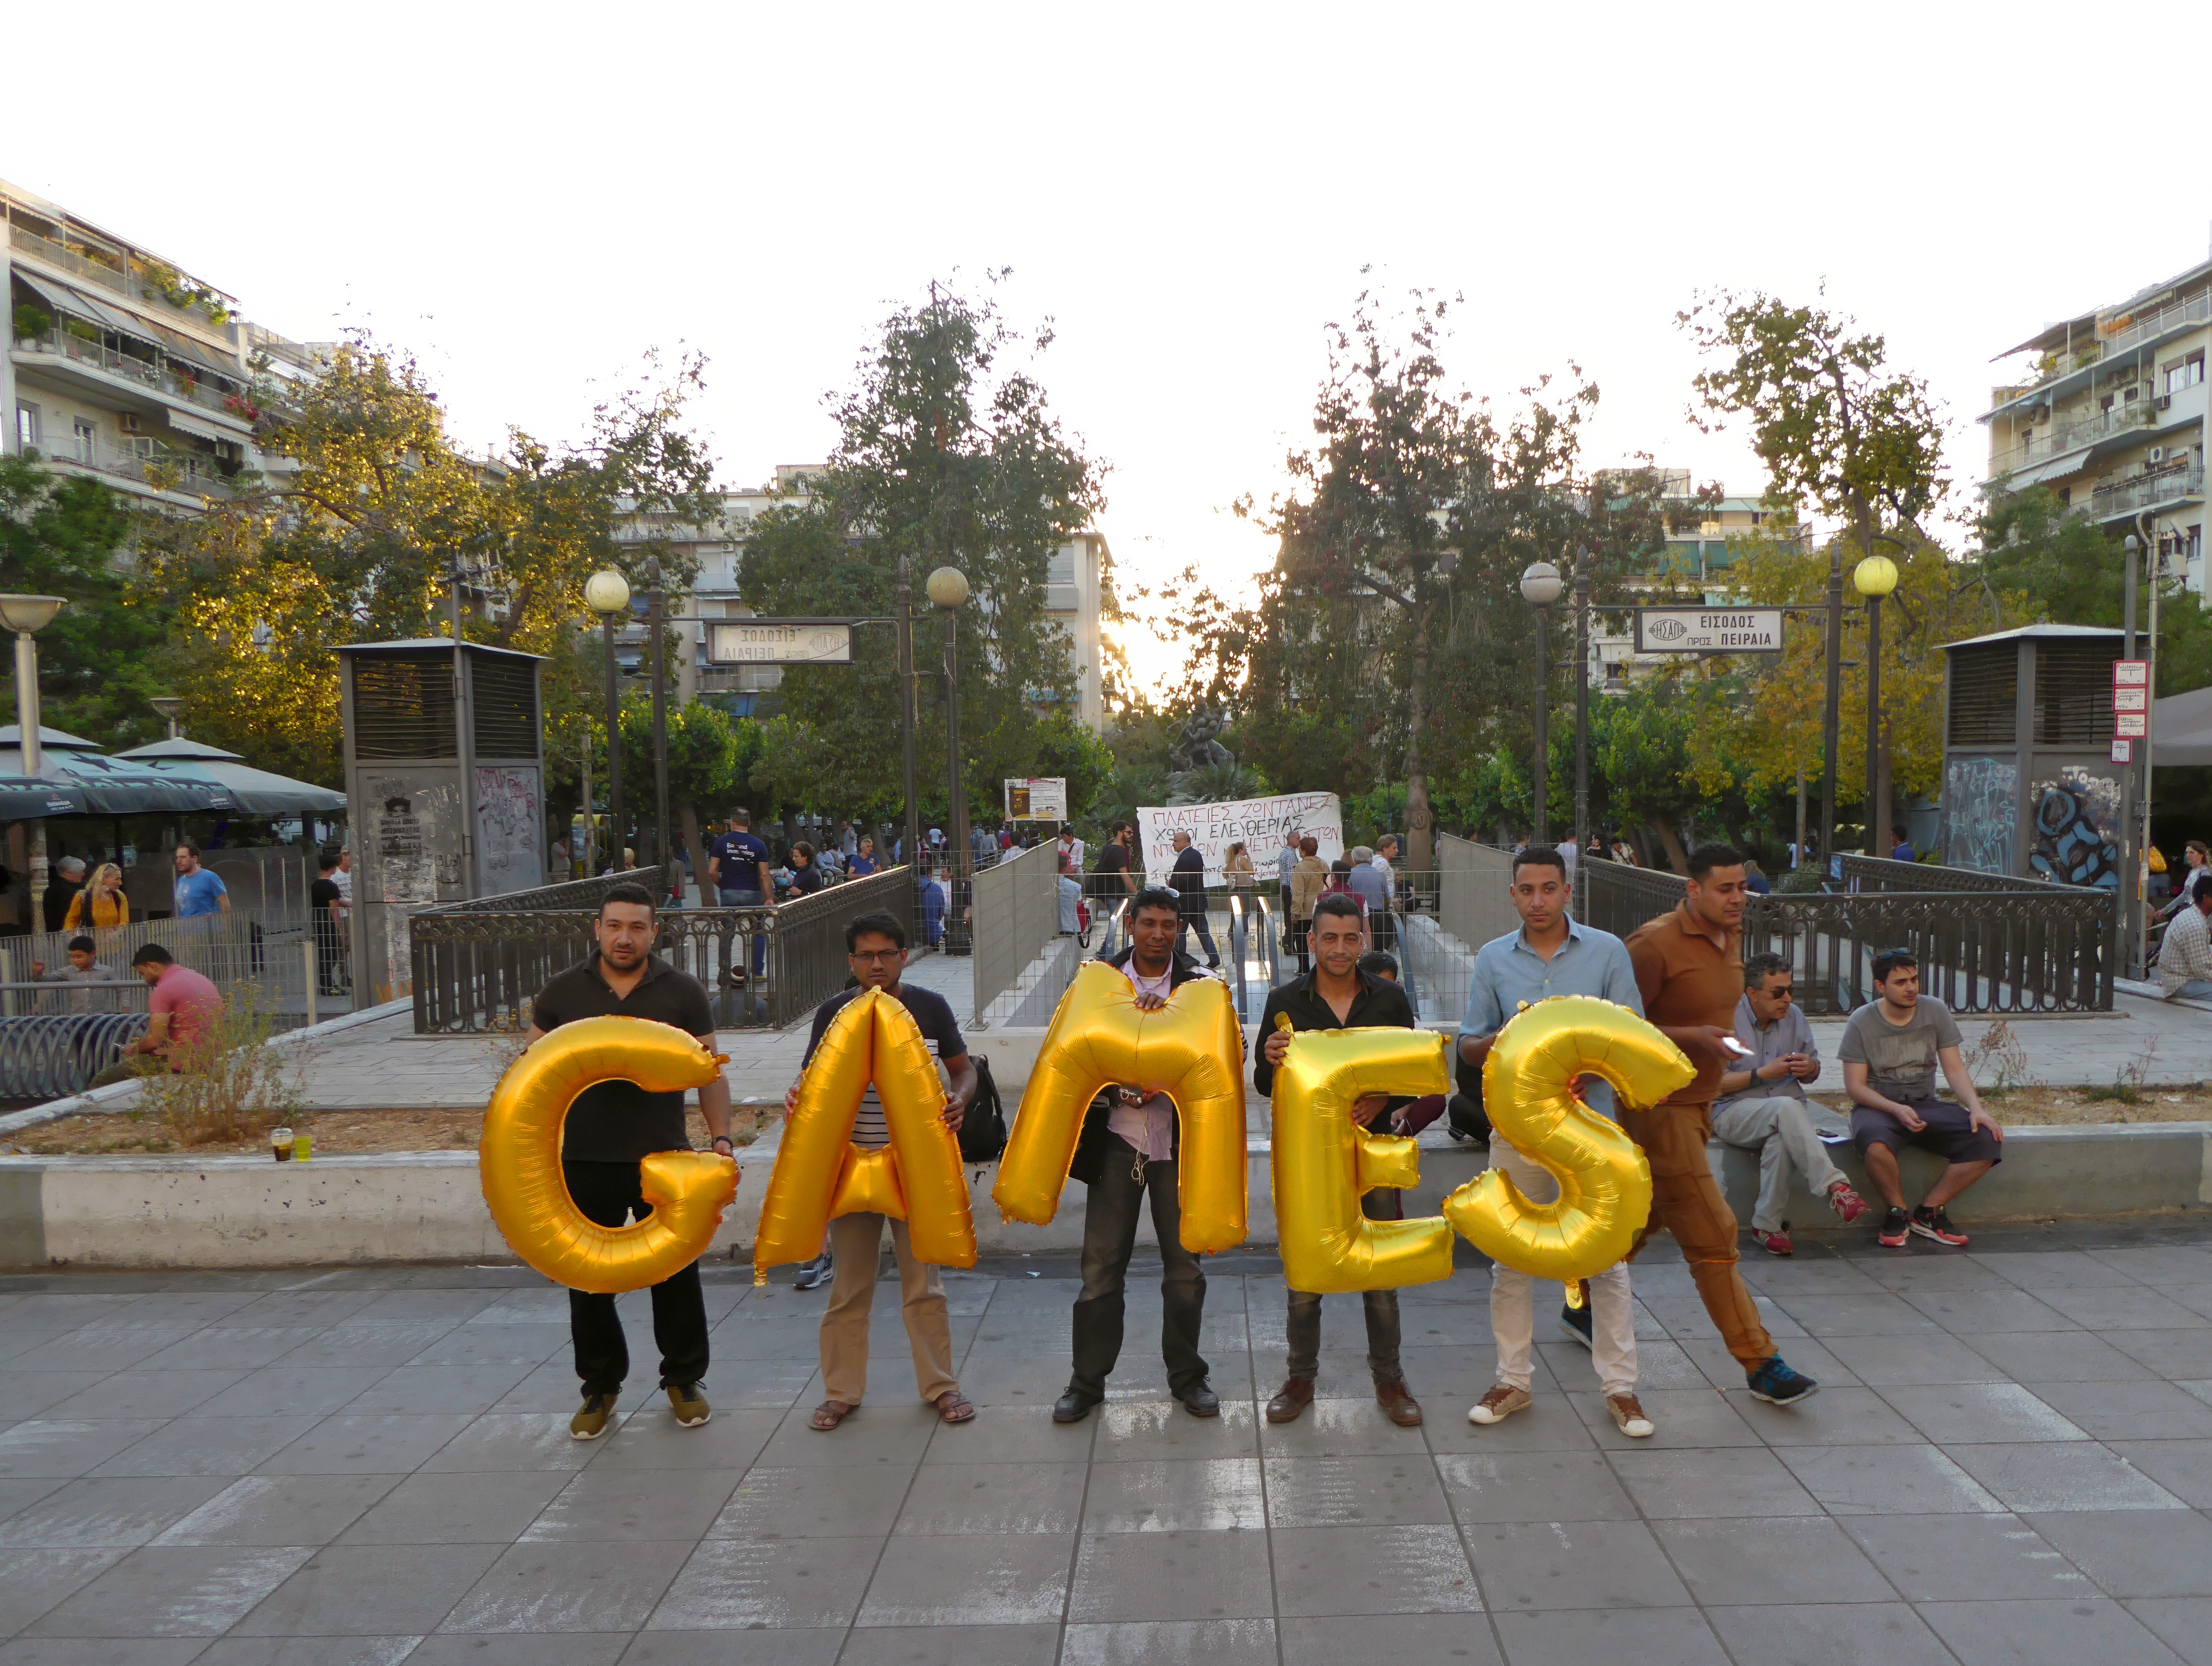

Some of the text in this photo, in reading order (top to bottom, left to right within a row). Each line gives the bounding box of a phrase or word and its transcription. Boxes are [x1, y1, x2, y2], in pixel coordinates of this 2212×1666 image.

[1656, 621, 1679, 639] ΗΣΑΠ
[1701, 615, 1755, 628] ΕΙΣΟΔΟΣ
[1687, 633, 1771, 646] ΠΡΟΣ ΠΕΙΡΑΙΑ
[1153, 805, 1234, 826] ΠΛΑΤΕΙΕΣ
[1210, 814, 1306, 839] ΕΛΕΥΘΕΡΙΑΣ
